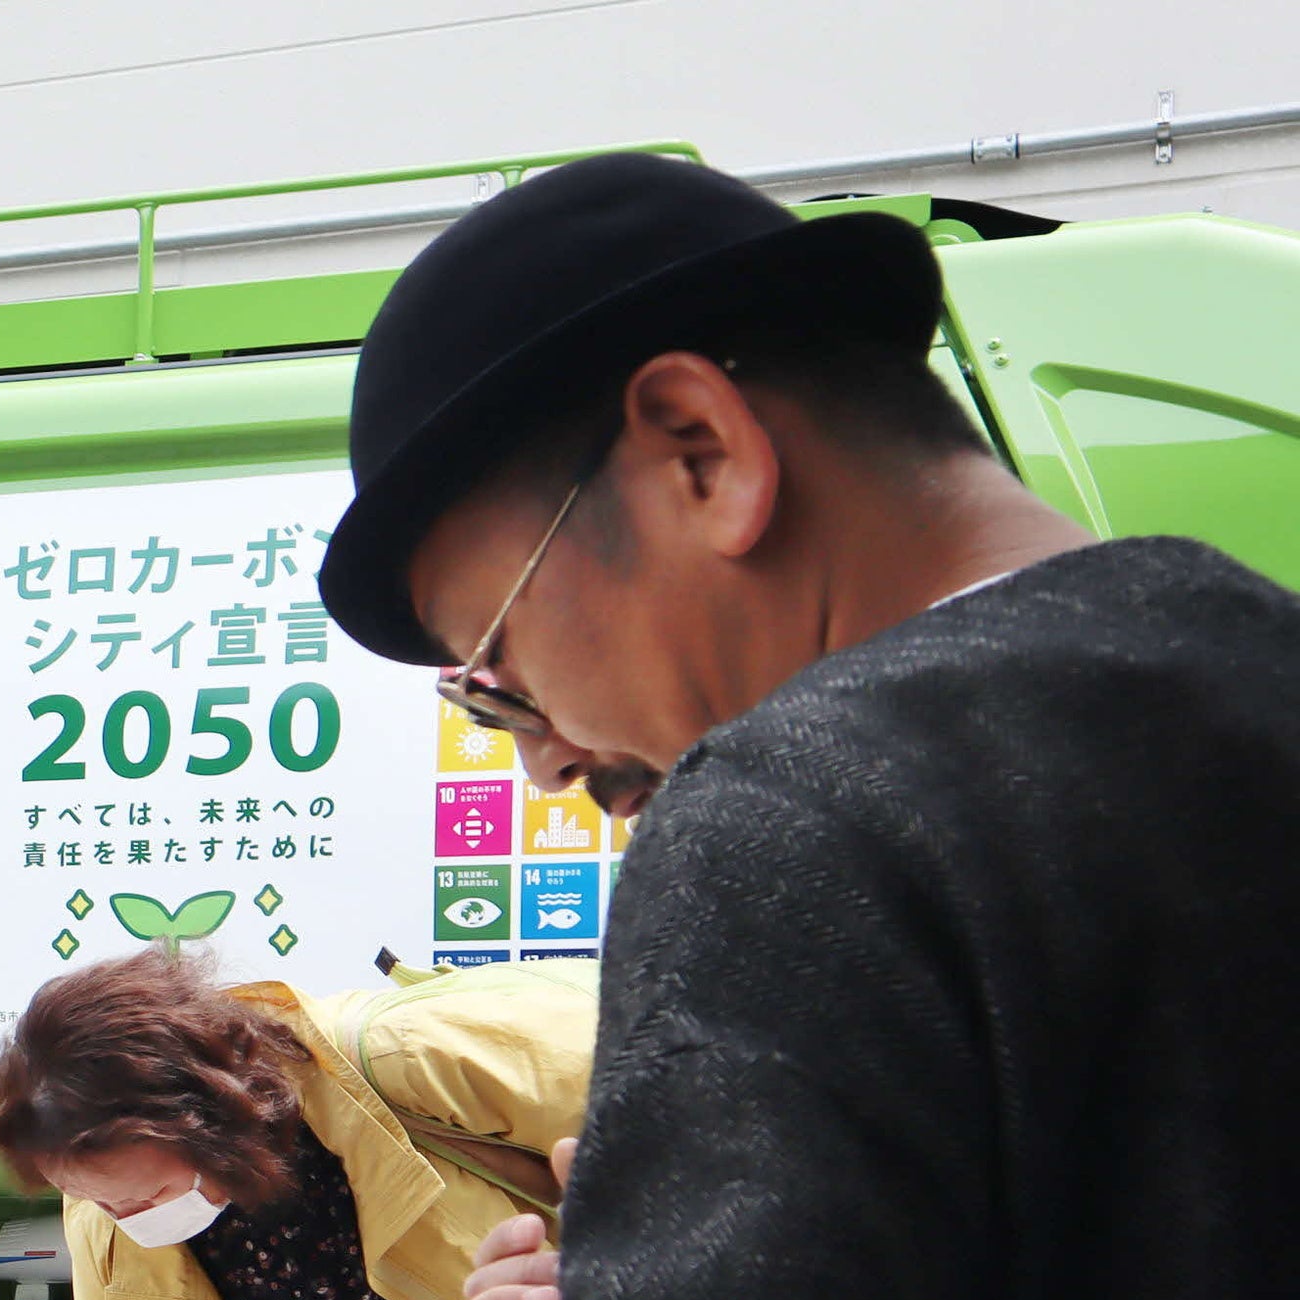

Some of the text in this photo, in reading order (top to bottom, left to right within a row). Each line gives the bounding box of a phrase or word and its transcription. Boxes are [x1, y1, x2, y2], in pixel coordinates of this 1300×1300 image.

[25, 602, 335, 674] シティ宣言
[22, 682, 341, 782] 2050
[439, 787, 456, 804] 10
[24, 796, 335, 830] すべては、未来への
[23, 835, 334, 867] 責任を果たすために
[438, 871, 454, 888] 13
[525, 869, 541, 886] 14
